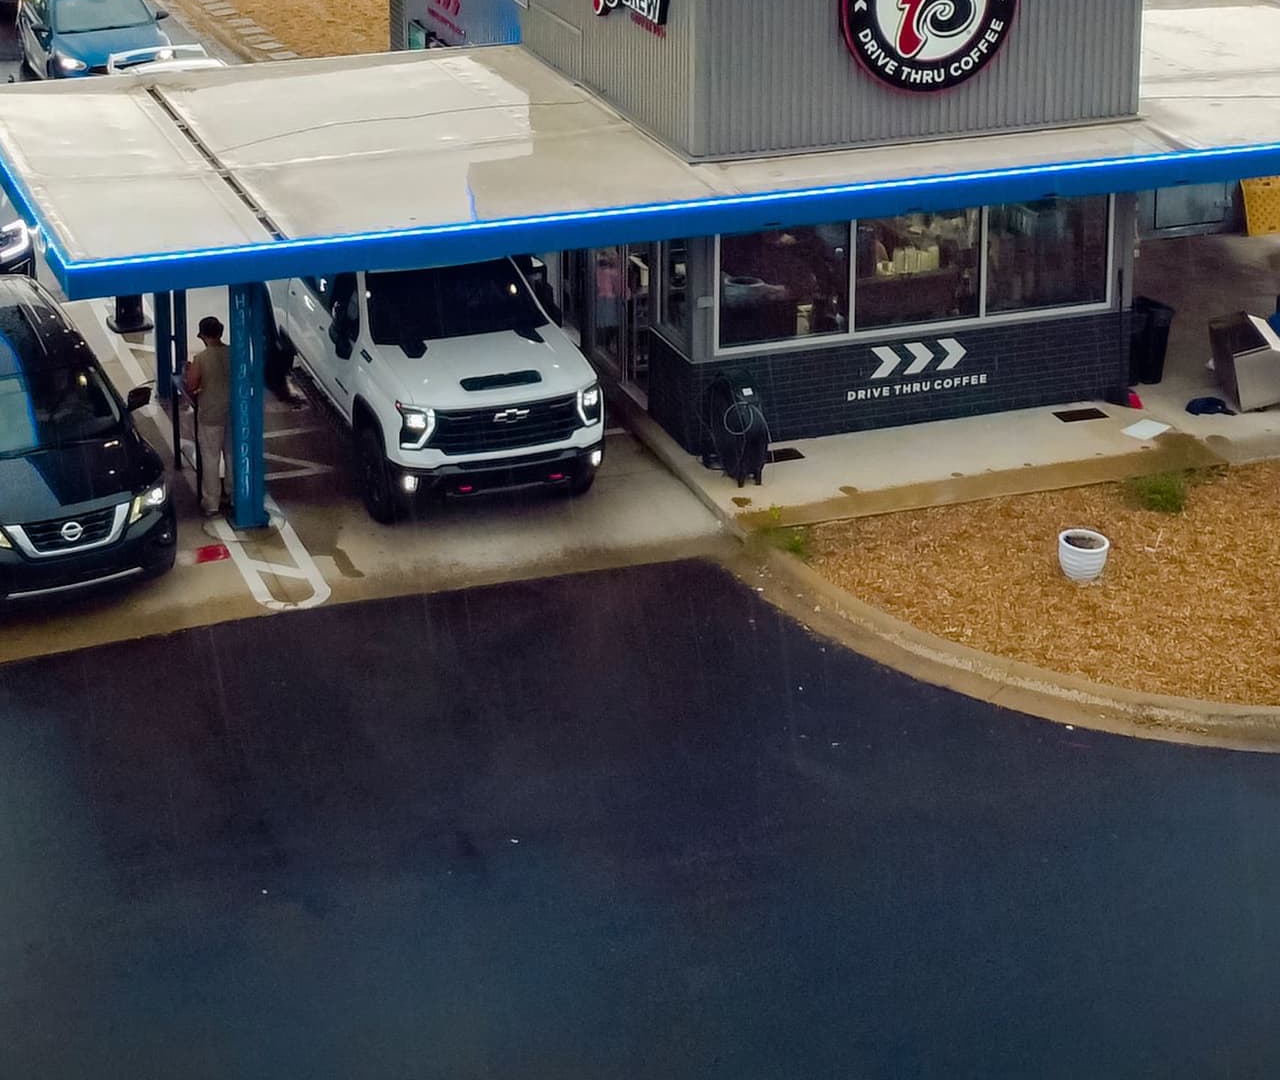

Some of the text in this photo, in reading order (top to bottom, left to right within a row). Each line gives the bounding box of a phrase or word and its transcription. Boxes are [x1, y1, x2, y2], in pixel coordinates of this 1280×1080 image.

[858, 18, 1004, 84] DRIVE THRU COFFEE
[847, 374, 987, 401] DRIVE THRU COFFEE
